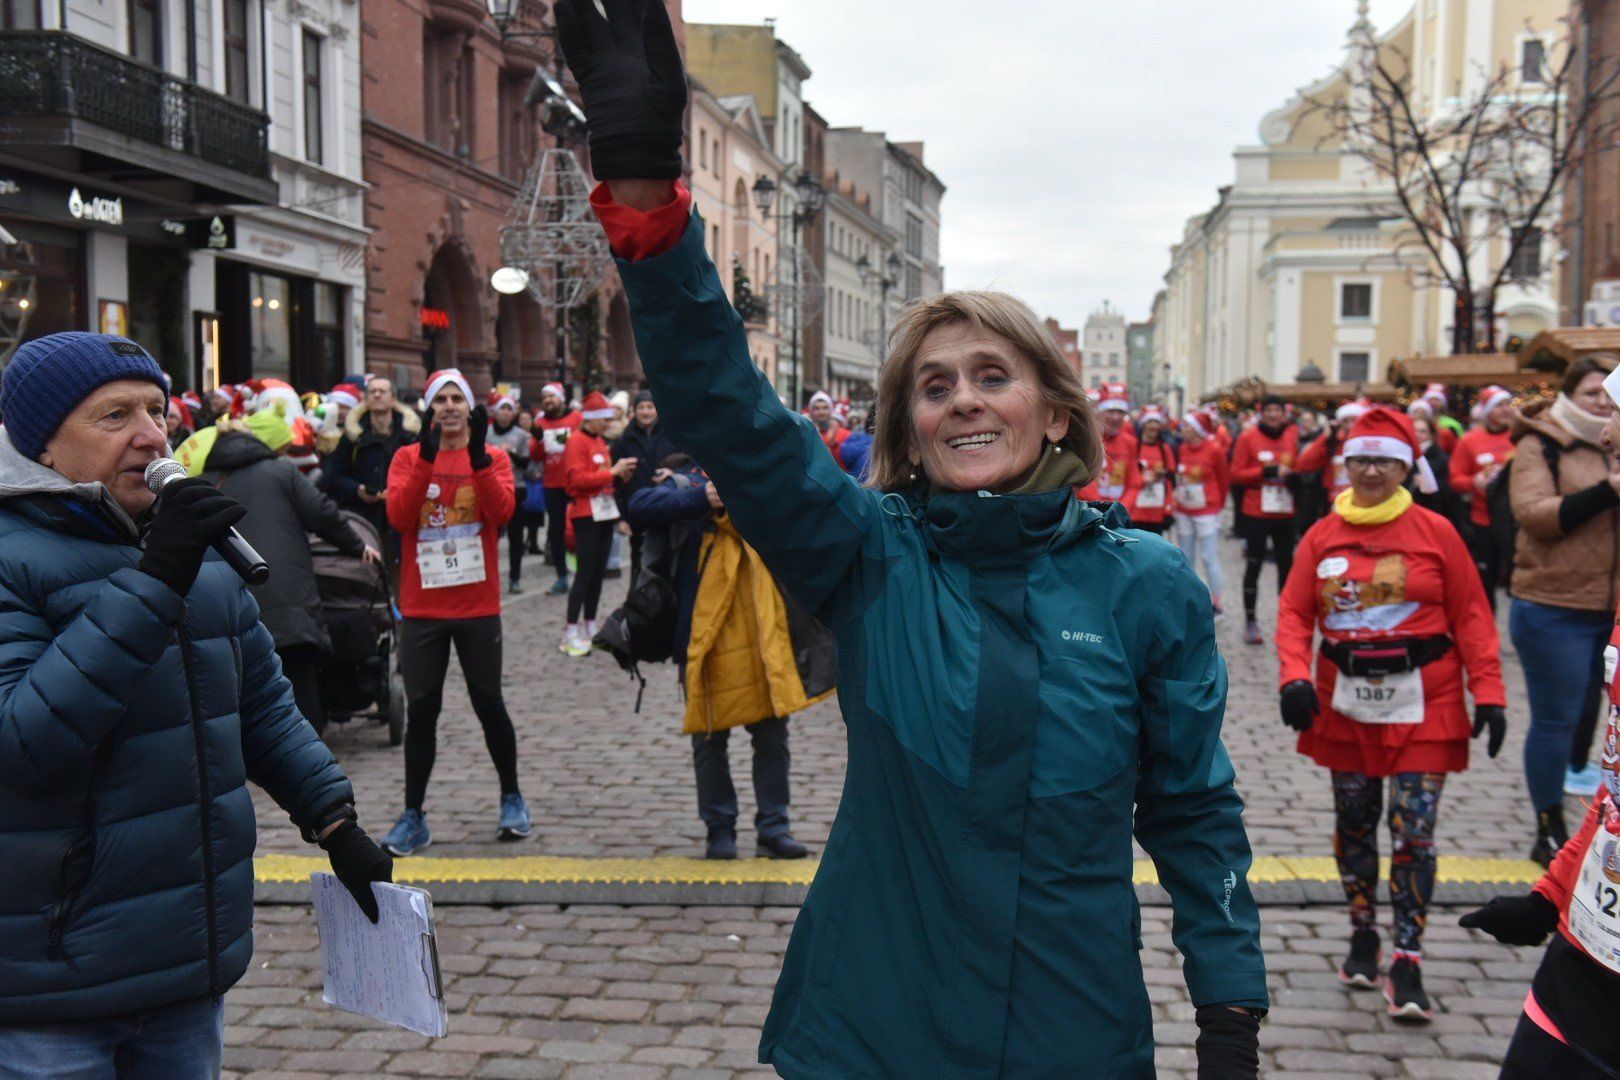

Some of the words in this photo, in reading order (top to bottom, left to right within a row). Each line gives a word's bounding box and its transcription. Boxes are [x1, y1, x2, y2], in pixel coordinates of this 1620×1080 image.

[445, 557, 458, 569] 51
[1071, 631, 1102, 643] HI-TEC
[1355, 687, 1396, 701] 1387
